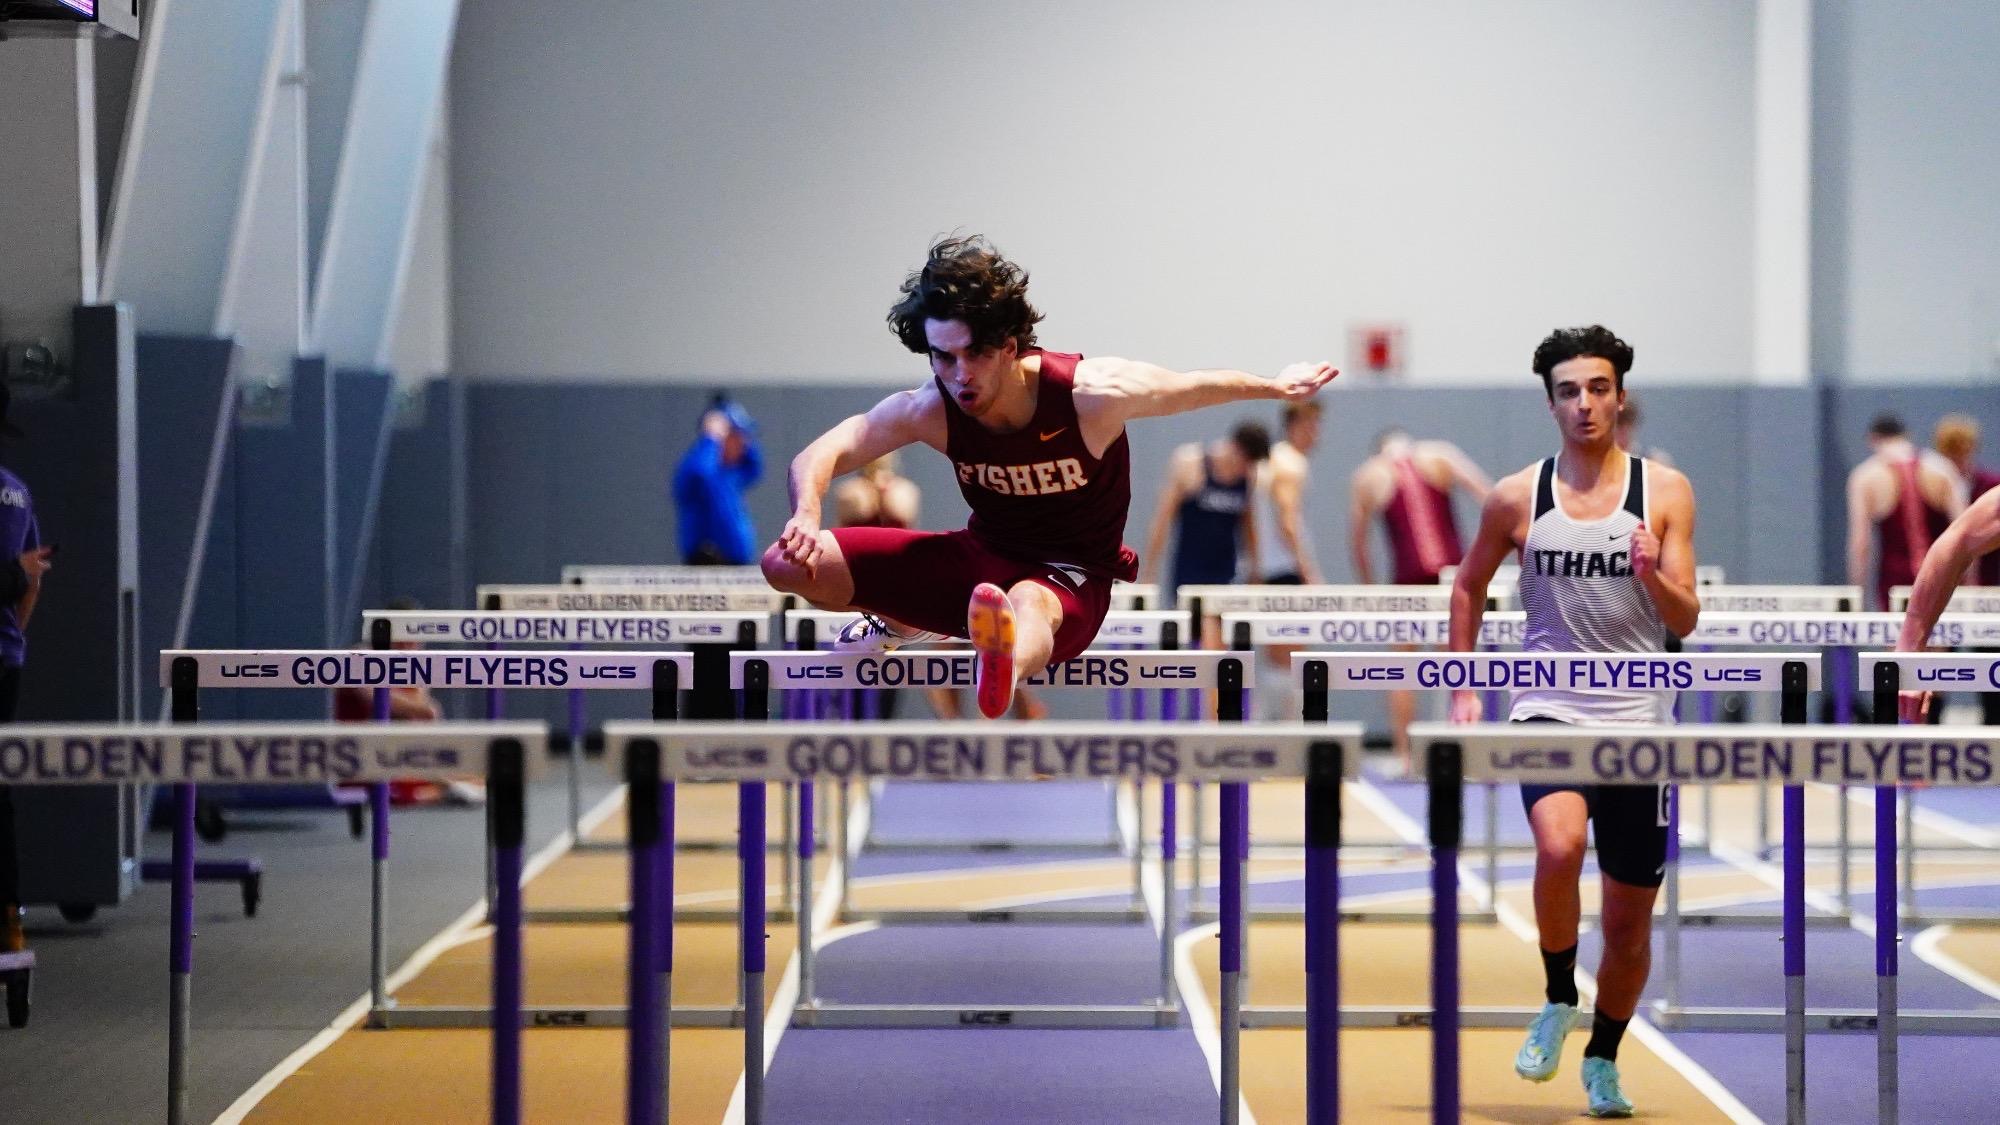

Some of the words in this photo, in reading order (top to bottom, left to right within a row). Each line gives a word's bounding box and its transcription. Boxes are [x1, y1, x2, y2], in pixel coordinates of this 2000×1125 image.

[957, 456, 1089, 496] FISHER
[1535, 550, 1635, 578] ITHAC
[459, 617, 567, 641] GOLDEN
[576, 617, 671, 642] FLYERS
[1320, 620, 1426, 643] GOLDEN
[1749, 620, 1858, 644] GOLDEN
[221, 664, 280, 678] UCS
[291, 656, 432, 686] GOLDEN
[445, 657, 569, 687] FLYERS
[579, 665, 637, 679] UCS
[786, 665, 844, 679] UCS
[855, 657, 977, 687] GOLDE
[1139, 665, 1198, 679] UCS
[1347, 667, 1406, 681] UCS
[1417, 659, 1557, 688] GOLDEN
[1569, 660, 1694, 690] FLYERS
[1704, 668, 1763, 682] UCS
[1917, 667, 1977, 682] UCS
[181, 736, 362, 780] FLYERS
[785, 736, 986, 778] GOLDEN
[1003, 737, 1180, 779] FLYERS
[1590, 738, 1795, 781] GOLDEN
[1810, 740, 1994, 784] FLYERS
